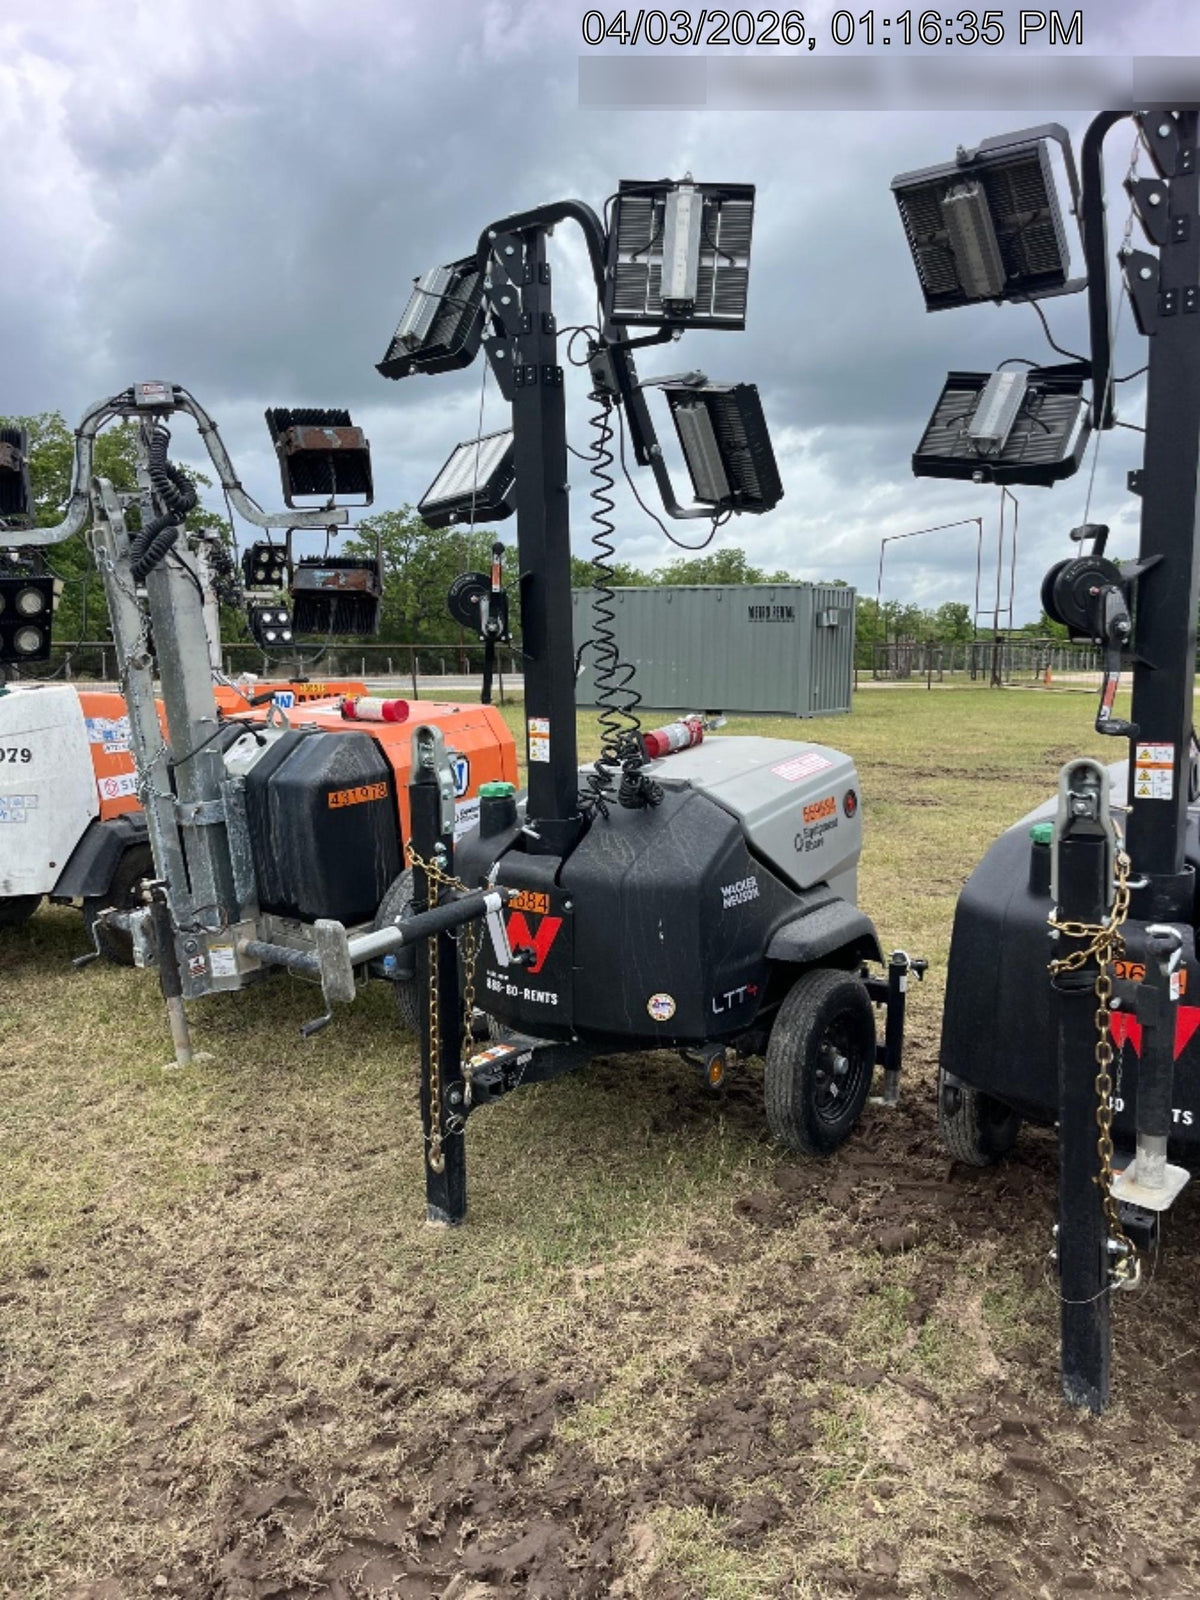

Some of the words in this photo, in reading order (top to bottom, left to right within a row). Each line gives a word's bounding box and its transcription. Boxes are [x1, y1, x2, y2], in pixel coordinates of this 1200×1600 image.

[328, 782, 387, 806] 431978
[720, 875, 759, 897] WACKER
[722, 886, 761, 909] NEUSON
